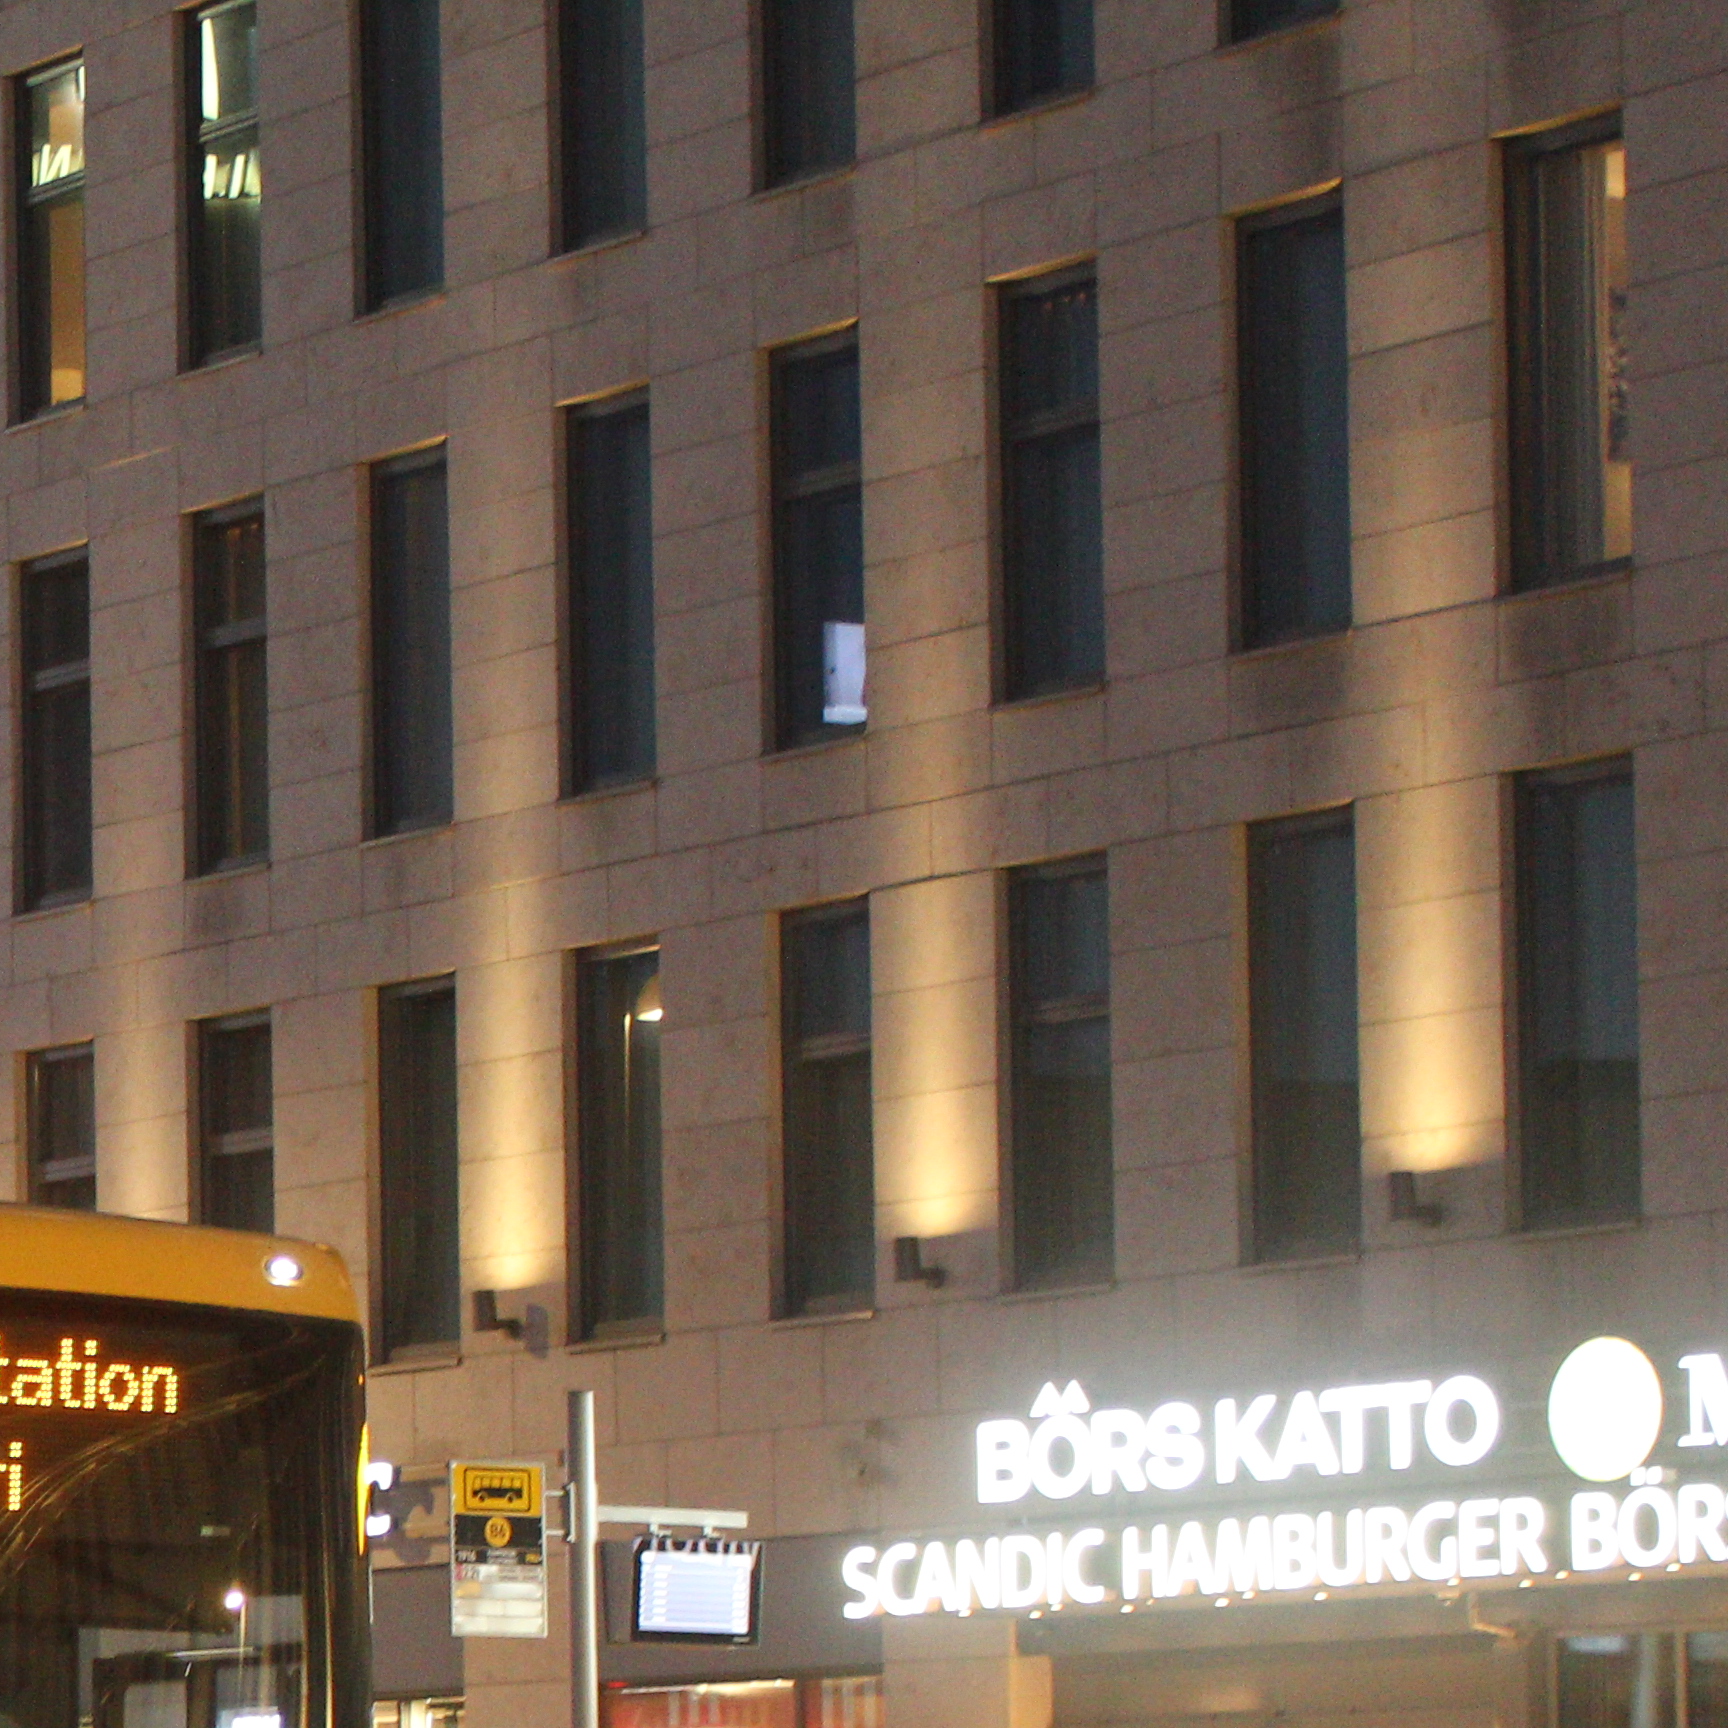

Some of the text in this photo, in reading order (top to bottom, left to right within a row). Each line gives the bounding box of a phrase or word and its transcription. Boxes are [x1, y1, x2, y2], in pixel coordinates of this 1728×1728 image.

[975, 1375, 1500, 1504] BÖRS KATTO
[841, 1527, 1106, 1620] SCANDIC
[1121, 1496, 1549, 1600] HAMBURGER
[1570, 1466, 1728, 1572] BÖR
